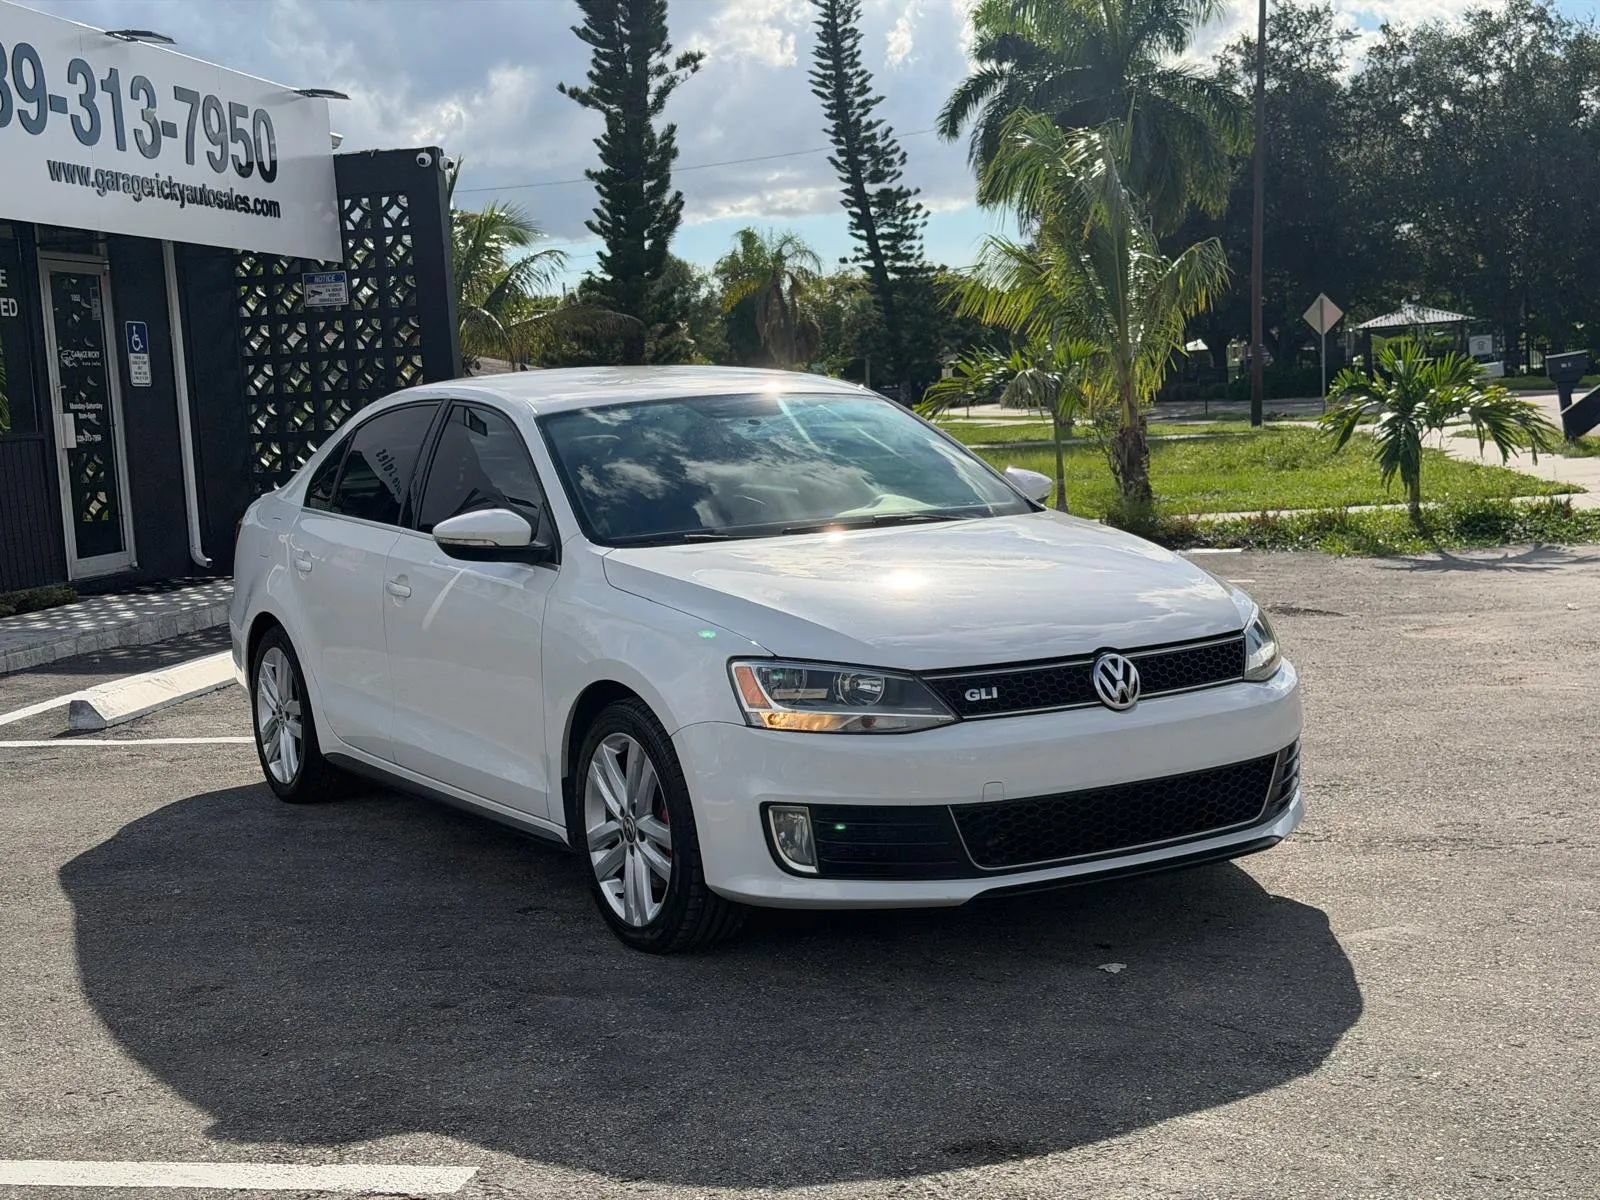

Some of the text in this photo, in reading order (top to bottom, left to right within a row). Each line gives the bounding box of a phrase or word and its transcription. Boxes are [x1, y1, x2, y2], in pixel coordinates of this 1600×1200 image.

[46, 159, 281, 219] www.garagerickyautosales.com
[314, 274, 336, 283] NOTICE
[964, 686, 998, 702] GLI
